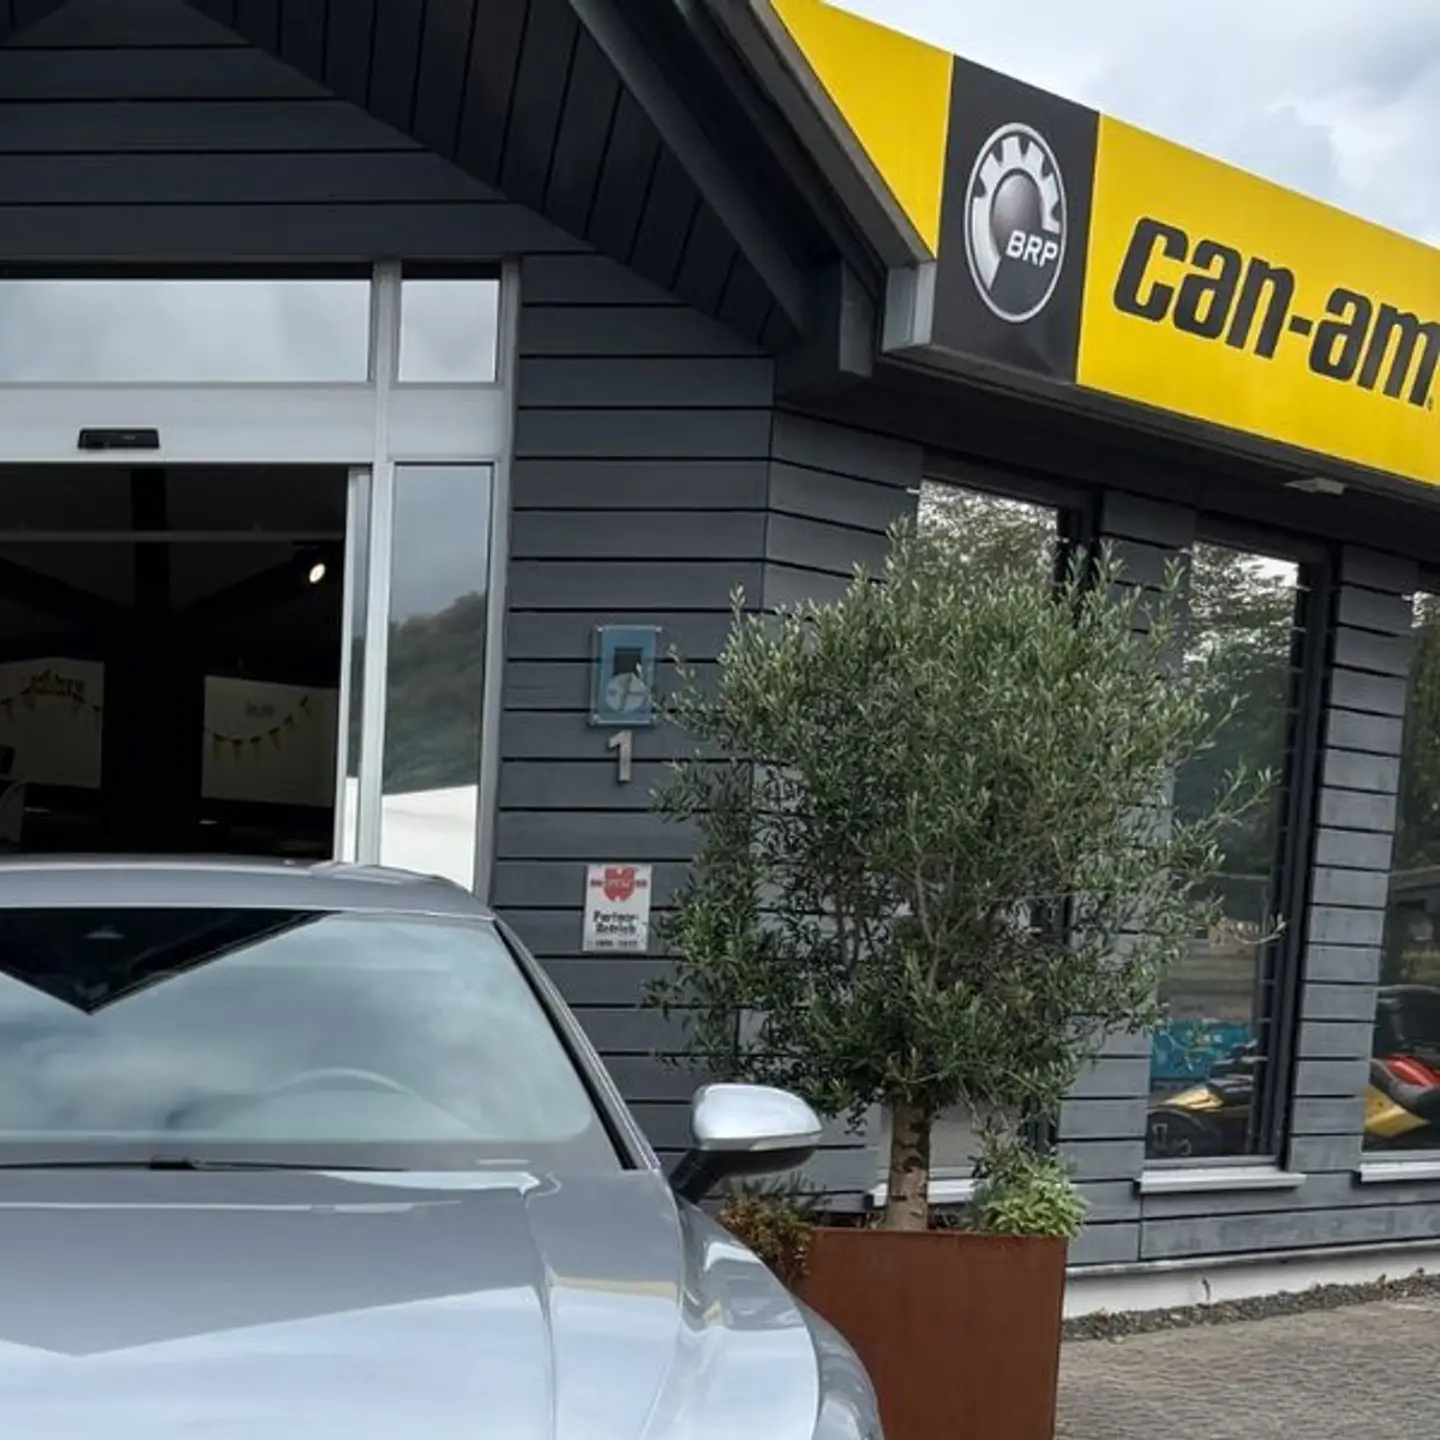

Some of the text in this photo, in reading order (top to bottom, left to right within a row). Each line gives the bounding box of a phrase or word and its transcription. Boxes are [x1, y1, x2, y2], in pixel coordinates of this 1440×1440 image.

[1006, 229, 1059, 269] BRP
[1112, 216, 1440, 408] can-am
[607, 730, 633, 782] 1
